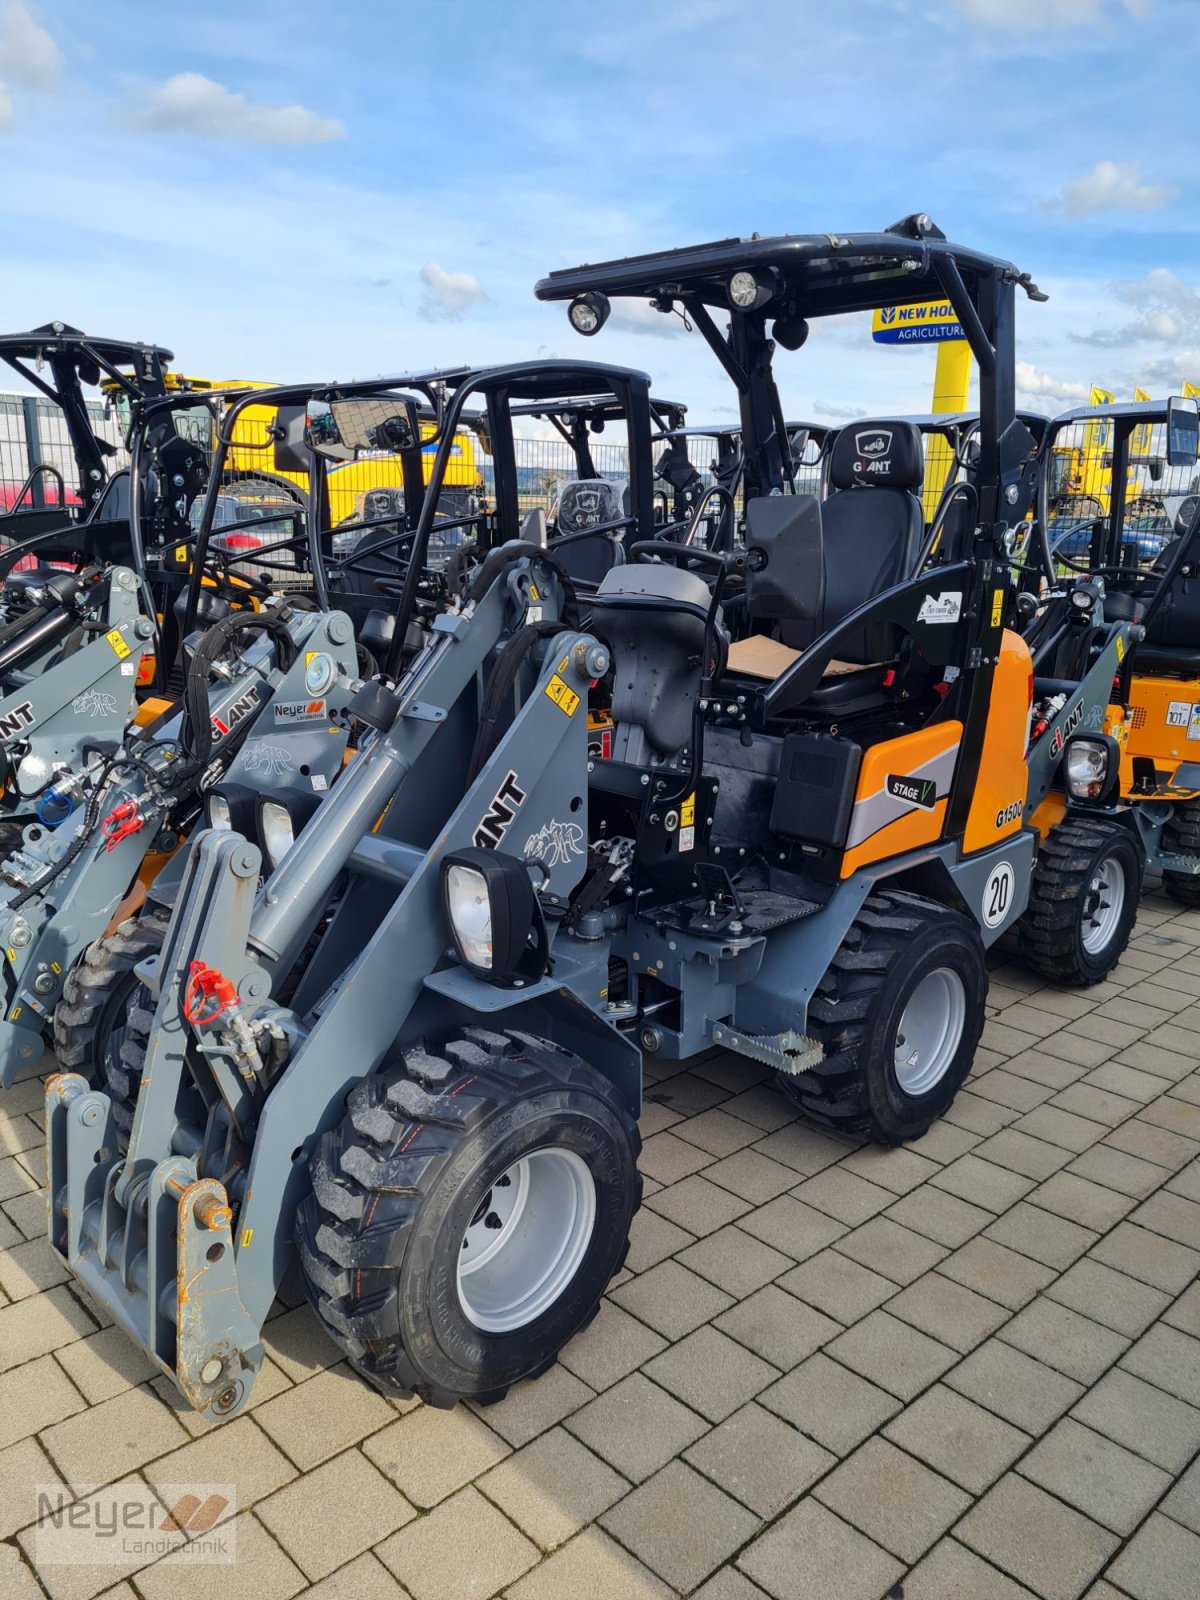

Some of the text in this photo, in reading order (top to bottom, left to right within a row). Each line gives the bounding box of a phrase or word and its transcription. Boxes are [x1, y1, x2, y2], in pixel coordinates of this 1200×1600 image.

[898, 307, 927, 320] NEW
[898, 326, 966, 339] AGRICULTURE
[576, 514, 600, 523] GANT
[275, 704, 307, 717] Neyer
[892, 778, 935, 802] STAGE V
[995, 800, 1023, 829] G1500
[988, 873, 1009, 918] 20
